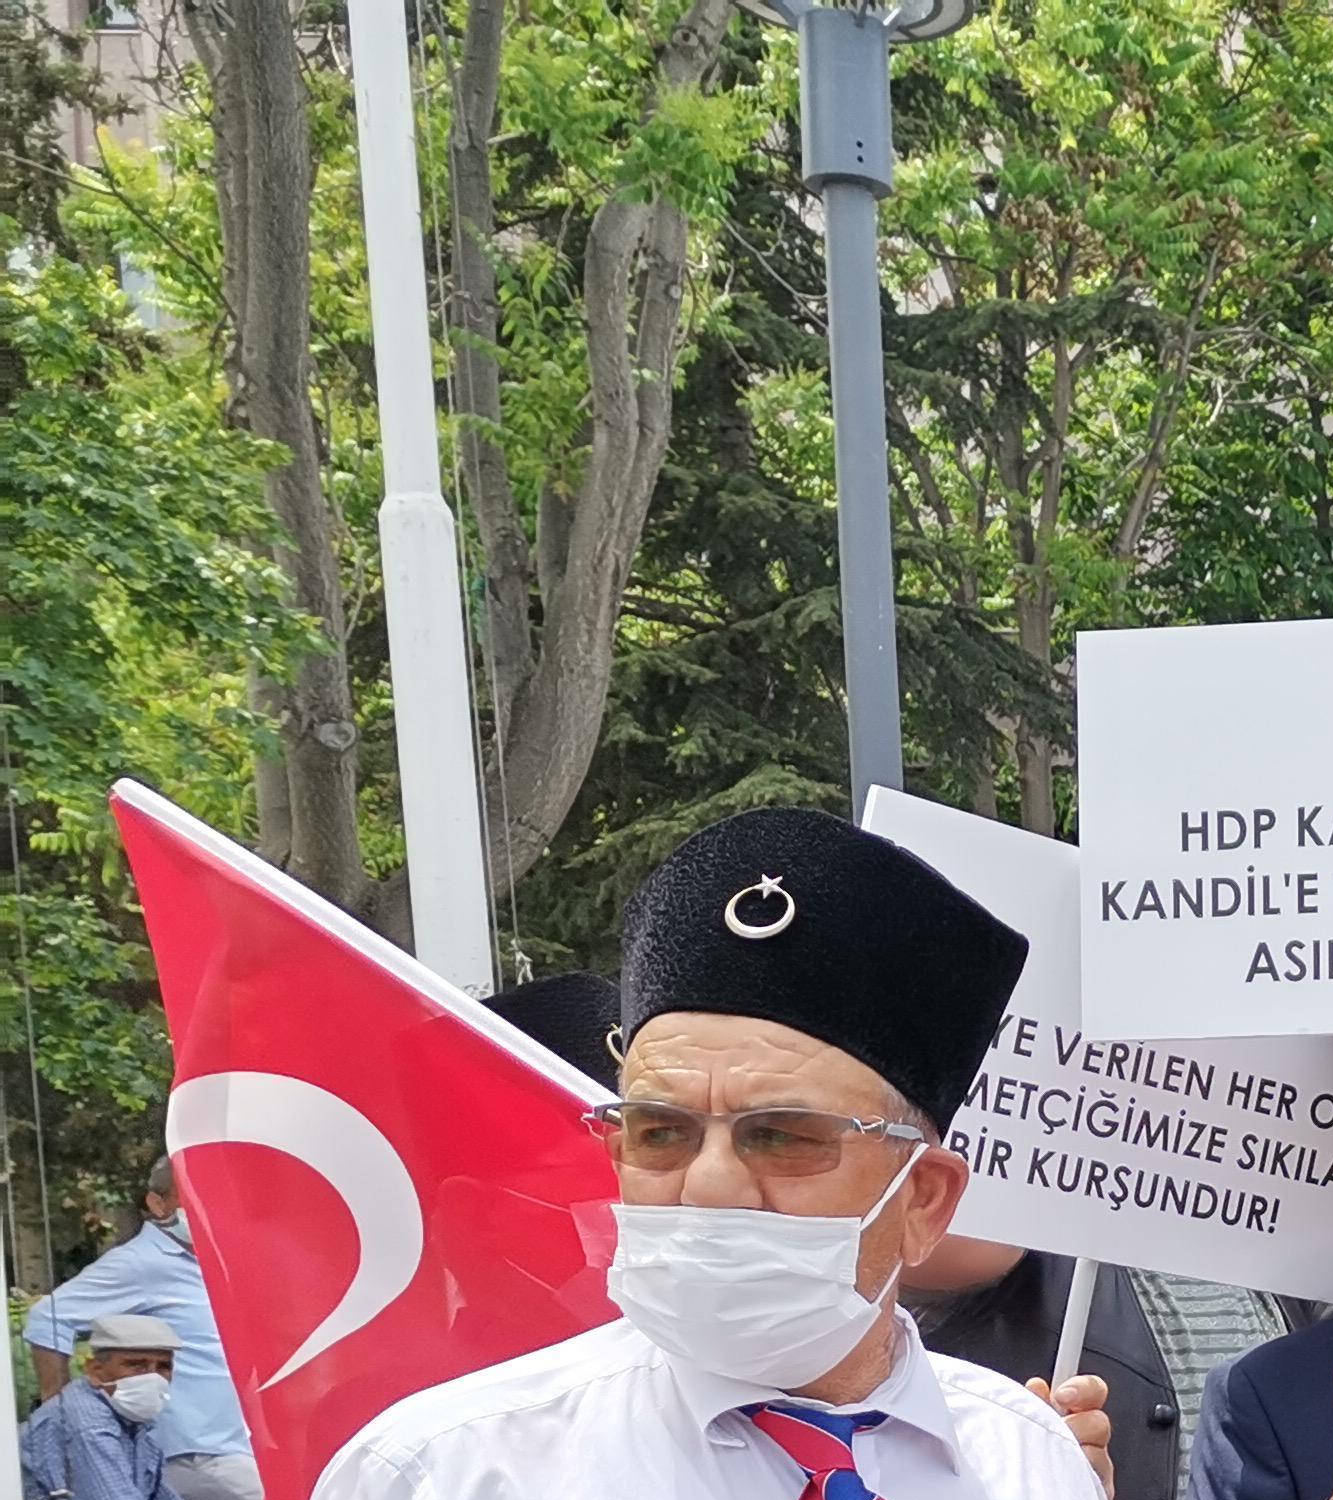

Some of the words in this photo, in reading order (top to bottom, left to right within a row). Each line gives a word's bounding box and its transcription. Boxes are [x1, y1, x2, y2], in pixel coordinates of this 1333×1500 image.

[1182, 809, 1276, 851] HDP
[1102, 866, 1318, 921] KANDİL'E
[1055, 1024, 1215, 1101] VERİLEN
[1226, 1071, 1298, 1122] HER
[948, 1126, 1008, 1180] BİR
[1026, 1147, 1281, 1234] KURŞUNDUR!
